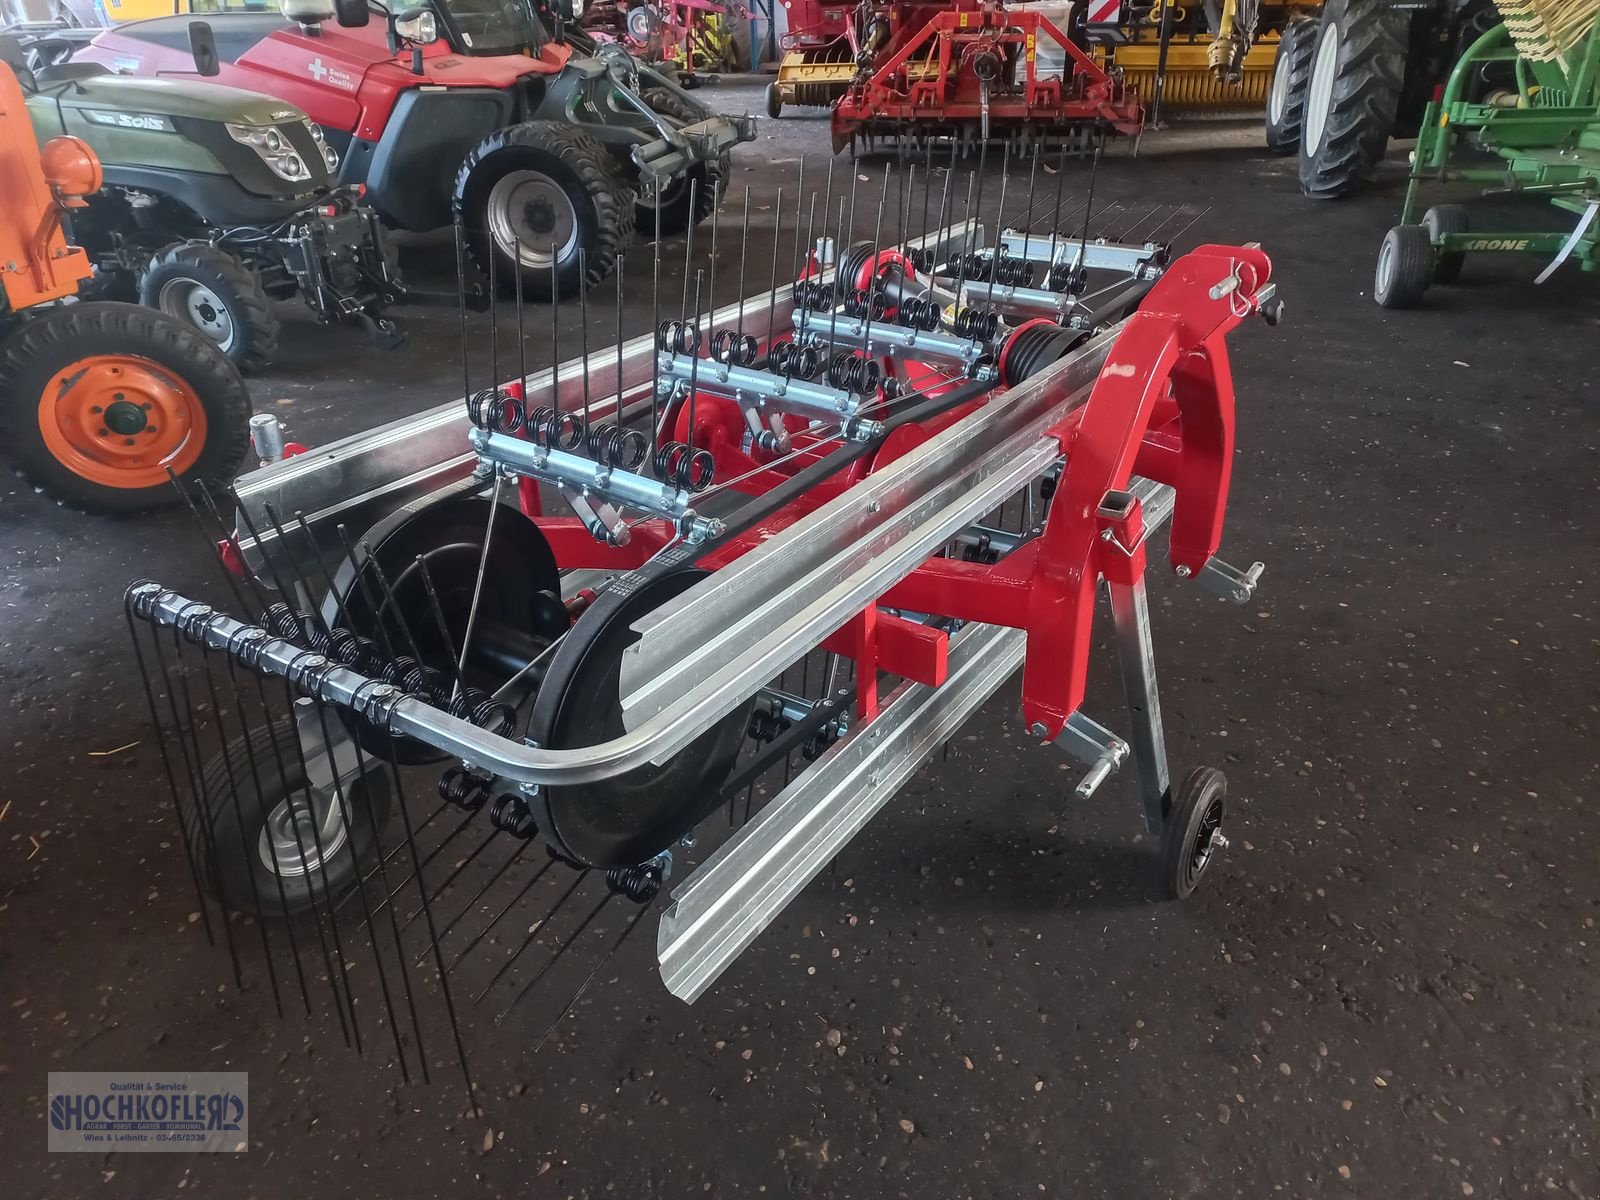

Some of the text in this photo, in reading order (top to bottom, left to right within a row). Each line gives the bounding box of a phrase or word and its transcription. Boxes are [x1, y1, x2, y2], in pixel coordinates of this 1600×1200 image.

[329, 68, 350, 80] Swiss
[329, 76, 353, 90] Quality
[1464, 239, 1530, 250] KRONE
